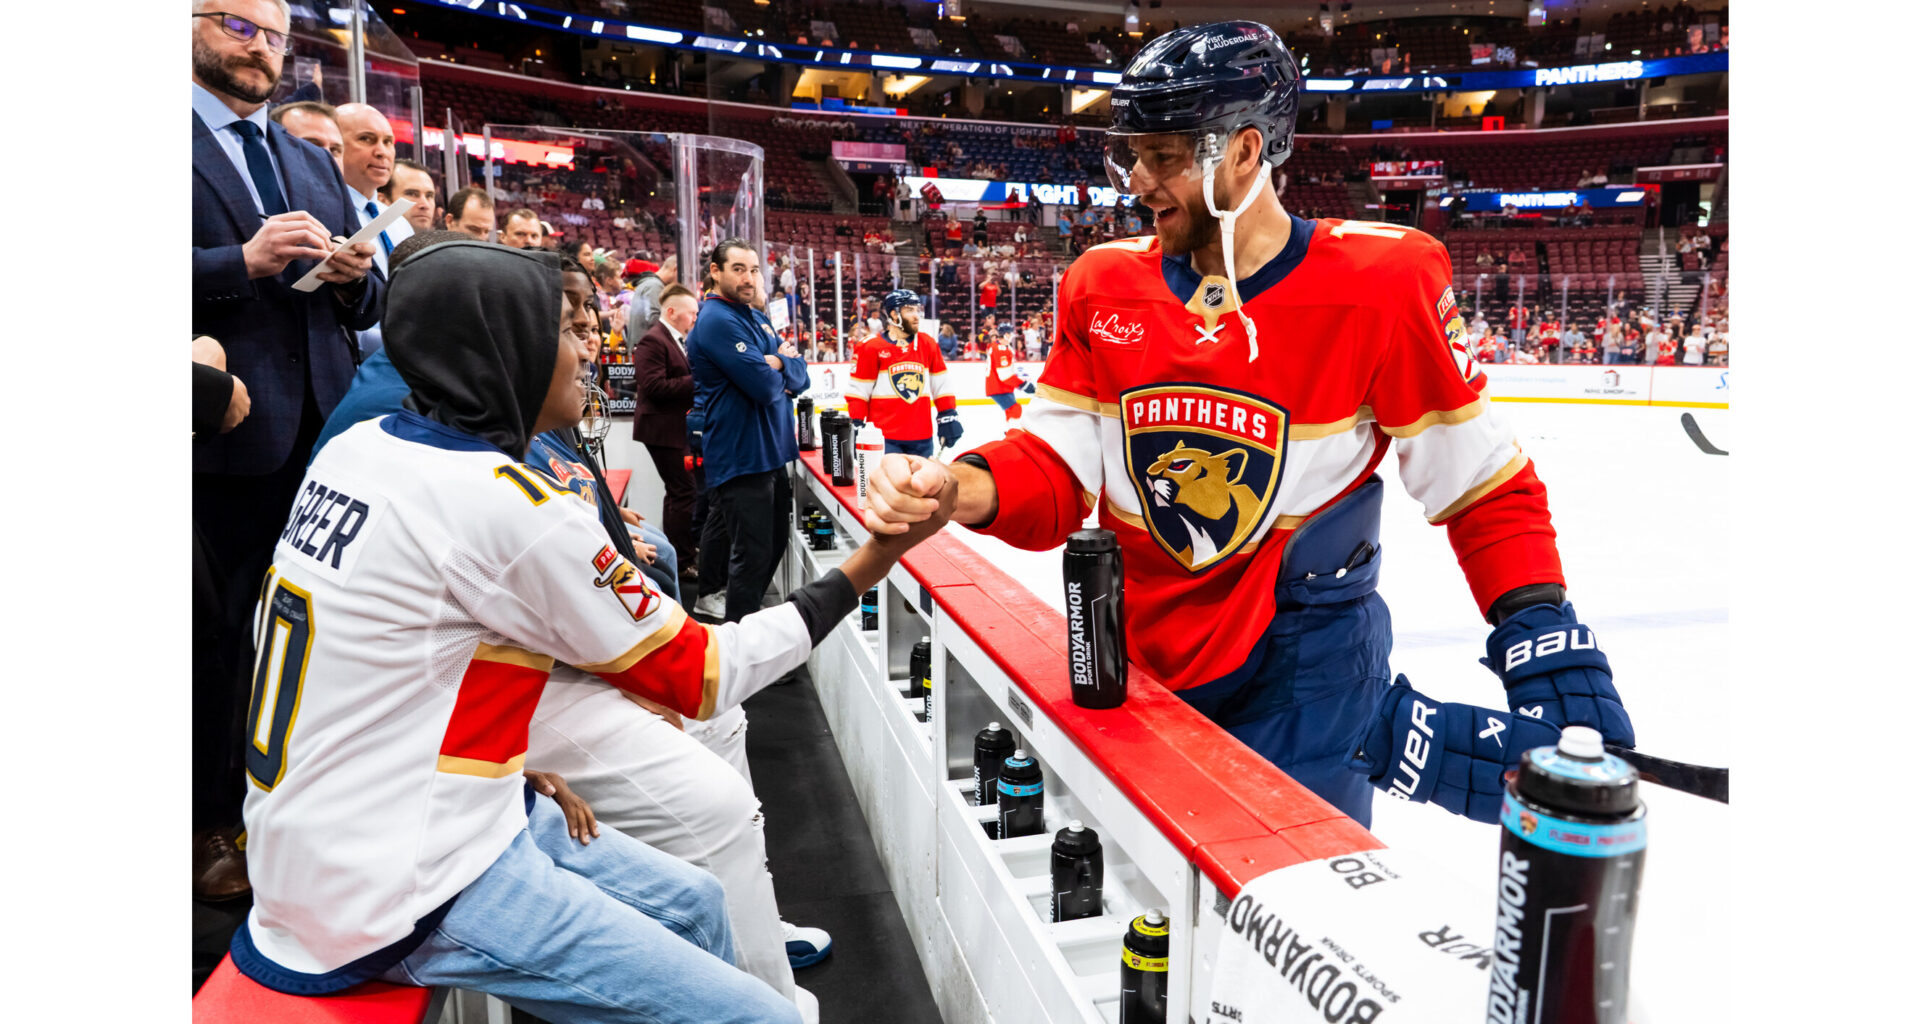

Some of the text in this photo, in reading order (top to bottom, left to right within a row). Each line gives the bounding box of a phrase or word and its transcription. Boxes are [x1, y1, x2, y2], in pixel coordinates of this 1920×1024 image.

[1206, 34, 1225, 44] VISIT
[1208, 33, 1258, 51] LAUDERDALE
[1535, 60, 1643, 86] PANTHERS
[995, 126, 1008, 134] OF
[1011, 127, 1039, 136] LIGHT
[1500, 192, 1577, 207] PANTHERS
[1089, 311, 1144, 340] LaCroix
[1133, 398, 1267, 440] PANTHERS
[282, 480, 370, 570] GREER
[1068, 581, 1088, 685] BODYARMOR
[1329, 858, 1387, 889] BO
[1319, 935, 1402, 1004] SPORTS DRINK
